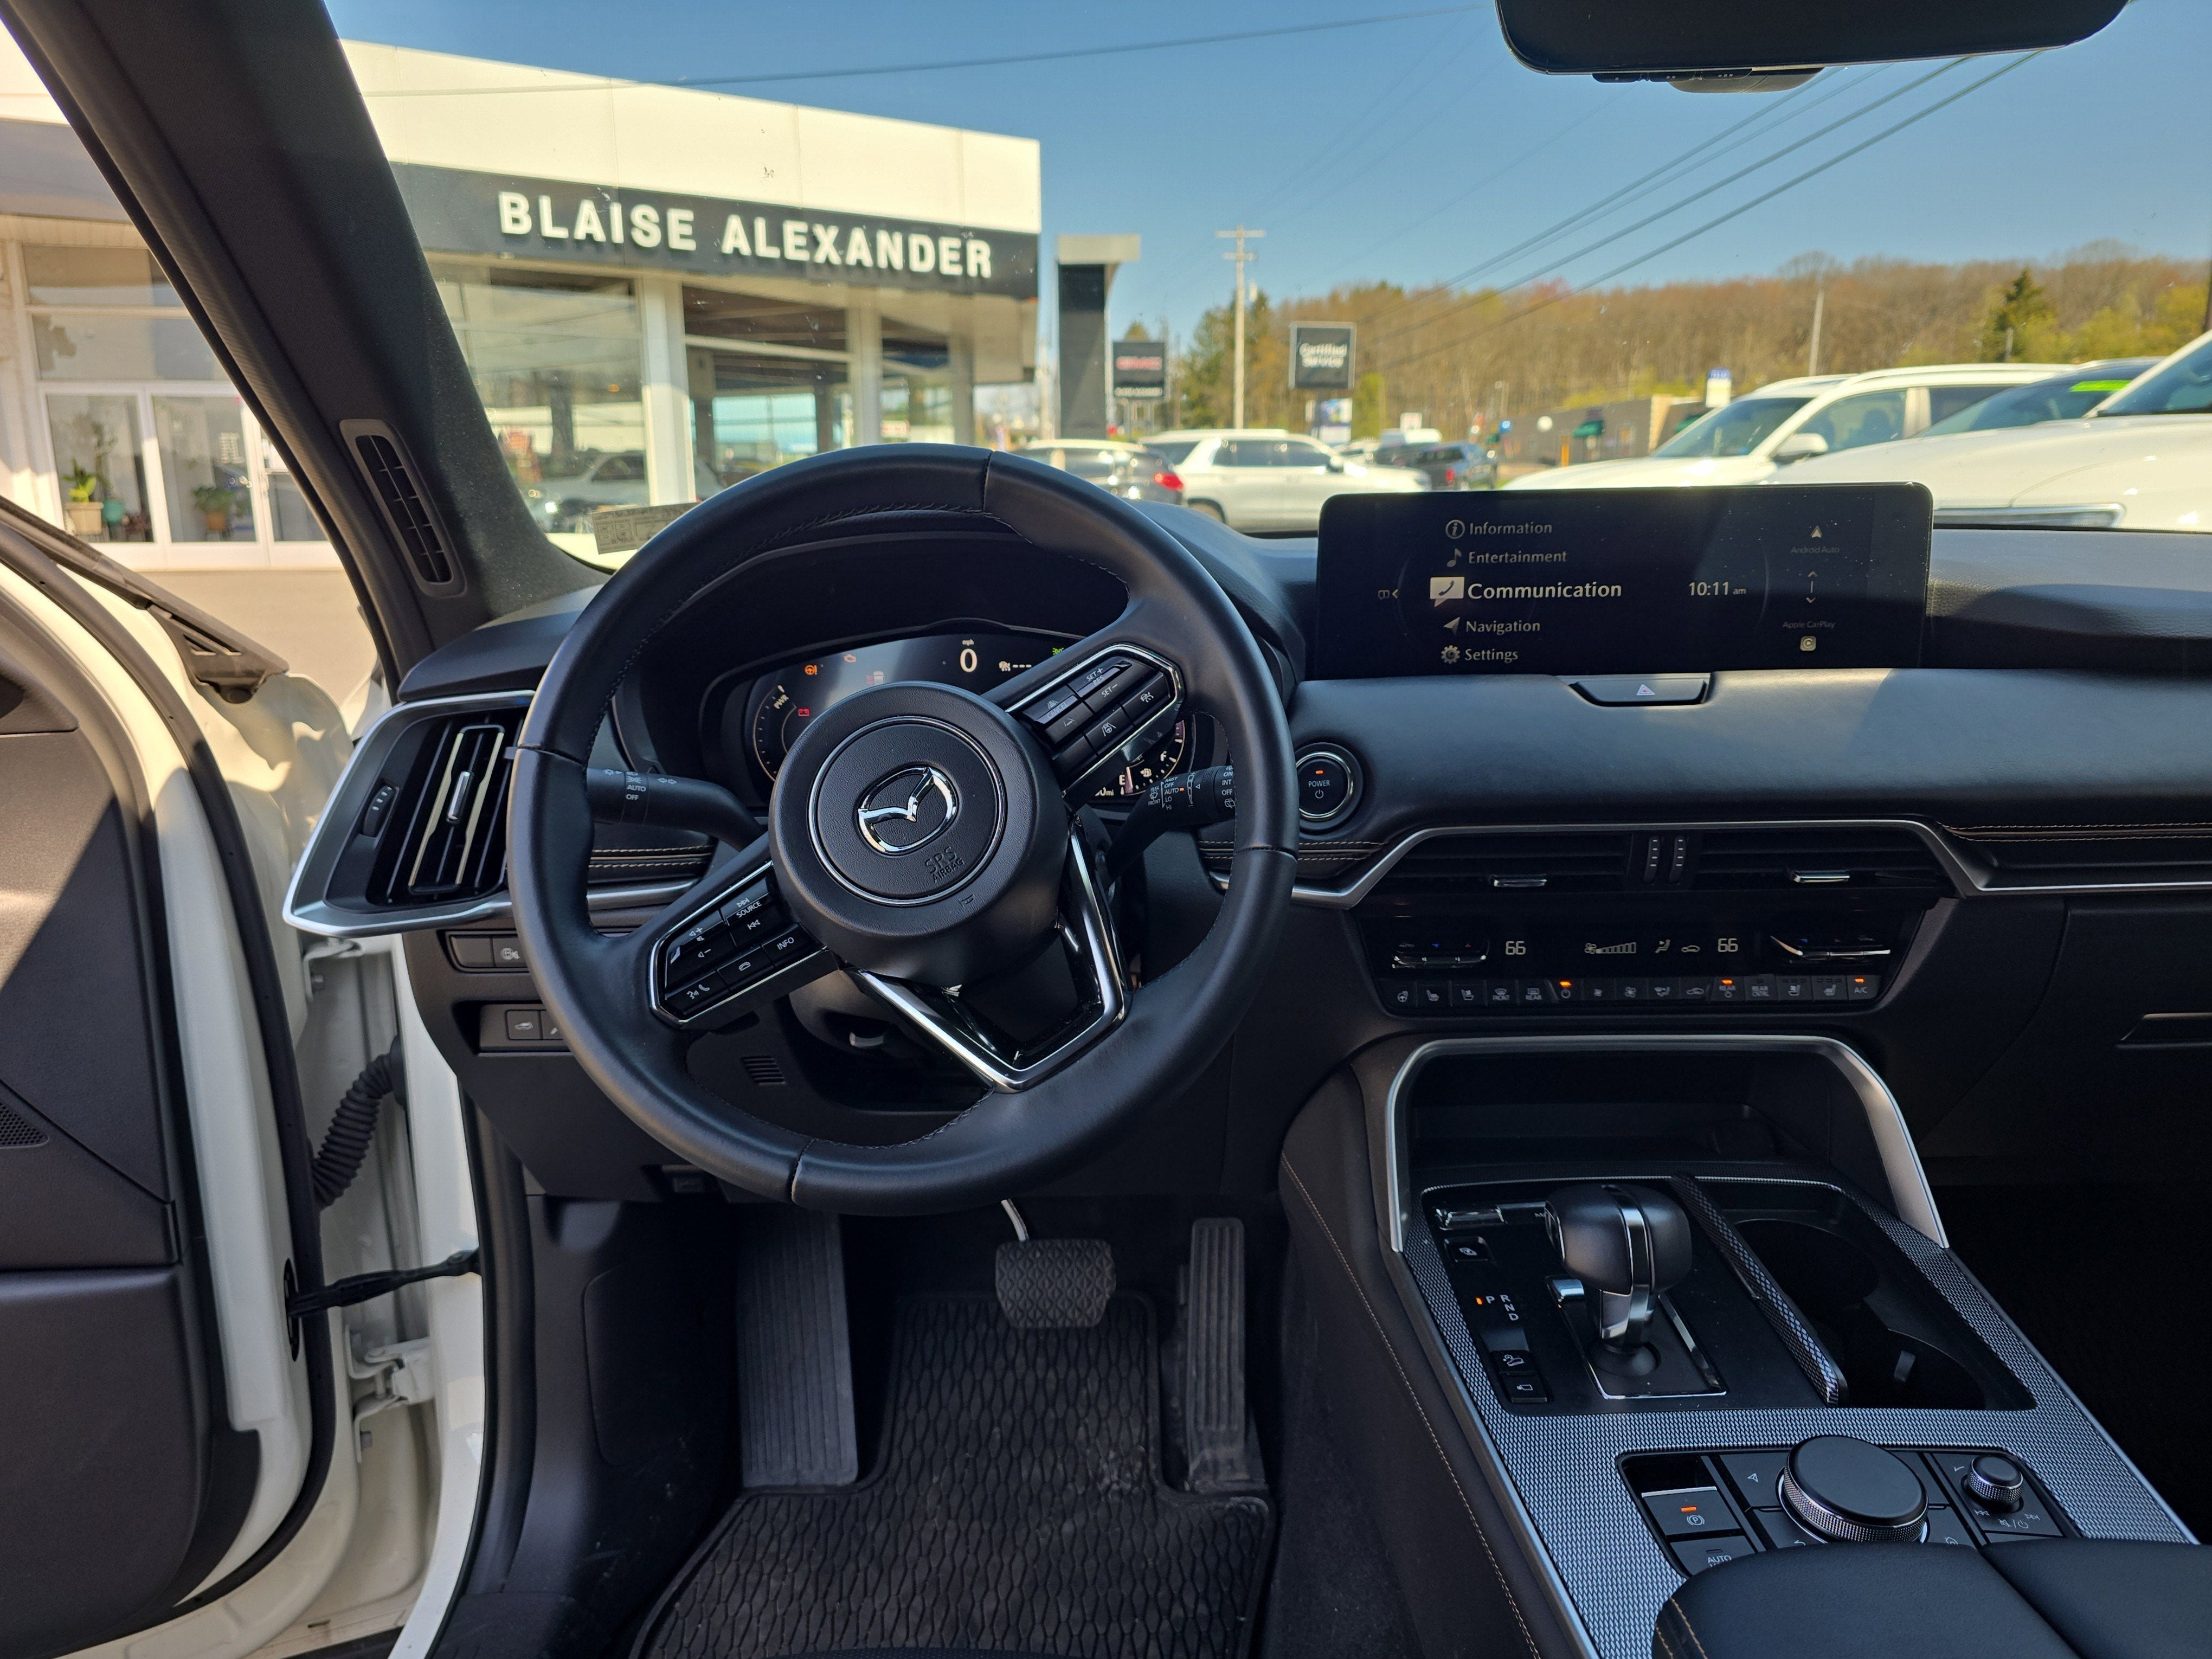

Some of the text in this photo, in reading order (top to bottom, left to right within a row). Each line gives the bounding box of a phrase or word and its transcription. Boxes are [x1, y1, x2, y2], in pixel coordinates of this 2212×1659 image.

[498, 191, 993, 279] BLAISE ALEXANDER
[1299, 342, 1348, 357] Certified
[1302, 356, 1343, 368] Service
[1469, 522, 1552, 535] Information
[1468, 551, 1567, 564] Entertainment
[1468, 582, 1622, 600] Communication
[1689, 582, 1729, 596] 10:11
[1465, 620, 1541, 636] Navigation
[1782, 620, 1836, 629] Apple CarPlay
[960, 648, 977, 672] 0
[1464, 648, 1519, 664] Settings
[774, 694, 789, 710] PWR
[1118, 774, 1126, 786] E
[1308, 780, 1330, 788] POWER
[1164, 787, 1179, 795] AUTO
[932, 857, 965, 883] AIRBAG
[736, 901, 762, 918] SOURCE
[776, 937, 794, 950] INFO
[1505, 941, 1526, 955] 66
[1717, 938, 1739, 953] 66
[1485, 1295, 1495, 1304] P
[1500, 1294, 1511, 1303] R
[1504, 1303, 1516, 1311] N
[1508, 1313, 1519, 1321] D
[1707, 1555, 1732, 1564] AUTO
